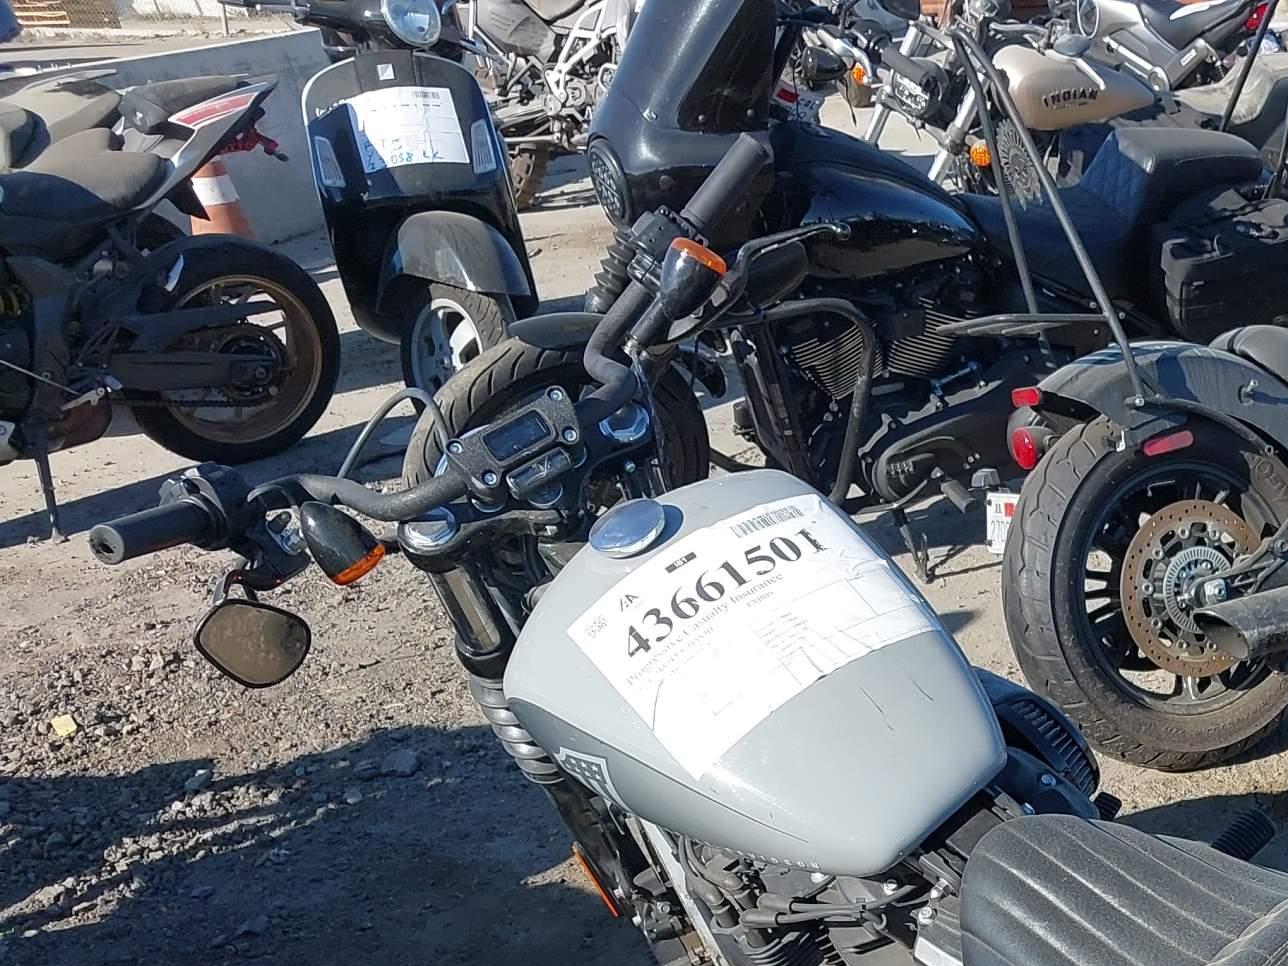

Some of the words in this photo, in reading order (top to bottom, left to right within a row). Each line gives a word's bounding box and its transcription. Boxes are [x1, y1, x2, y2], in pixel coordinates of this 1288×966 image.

[1042, 88, 1098, 108] INDIAN
[627, 529, 828, 657] 43661501
[683, 602, 728, 636] Casualty
[729, 573, 784, 605] Insurance
